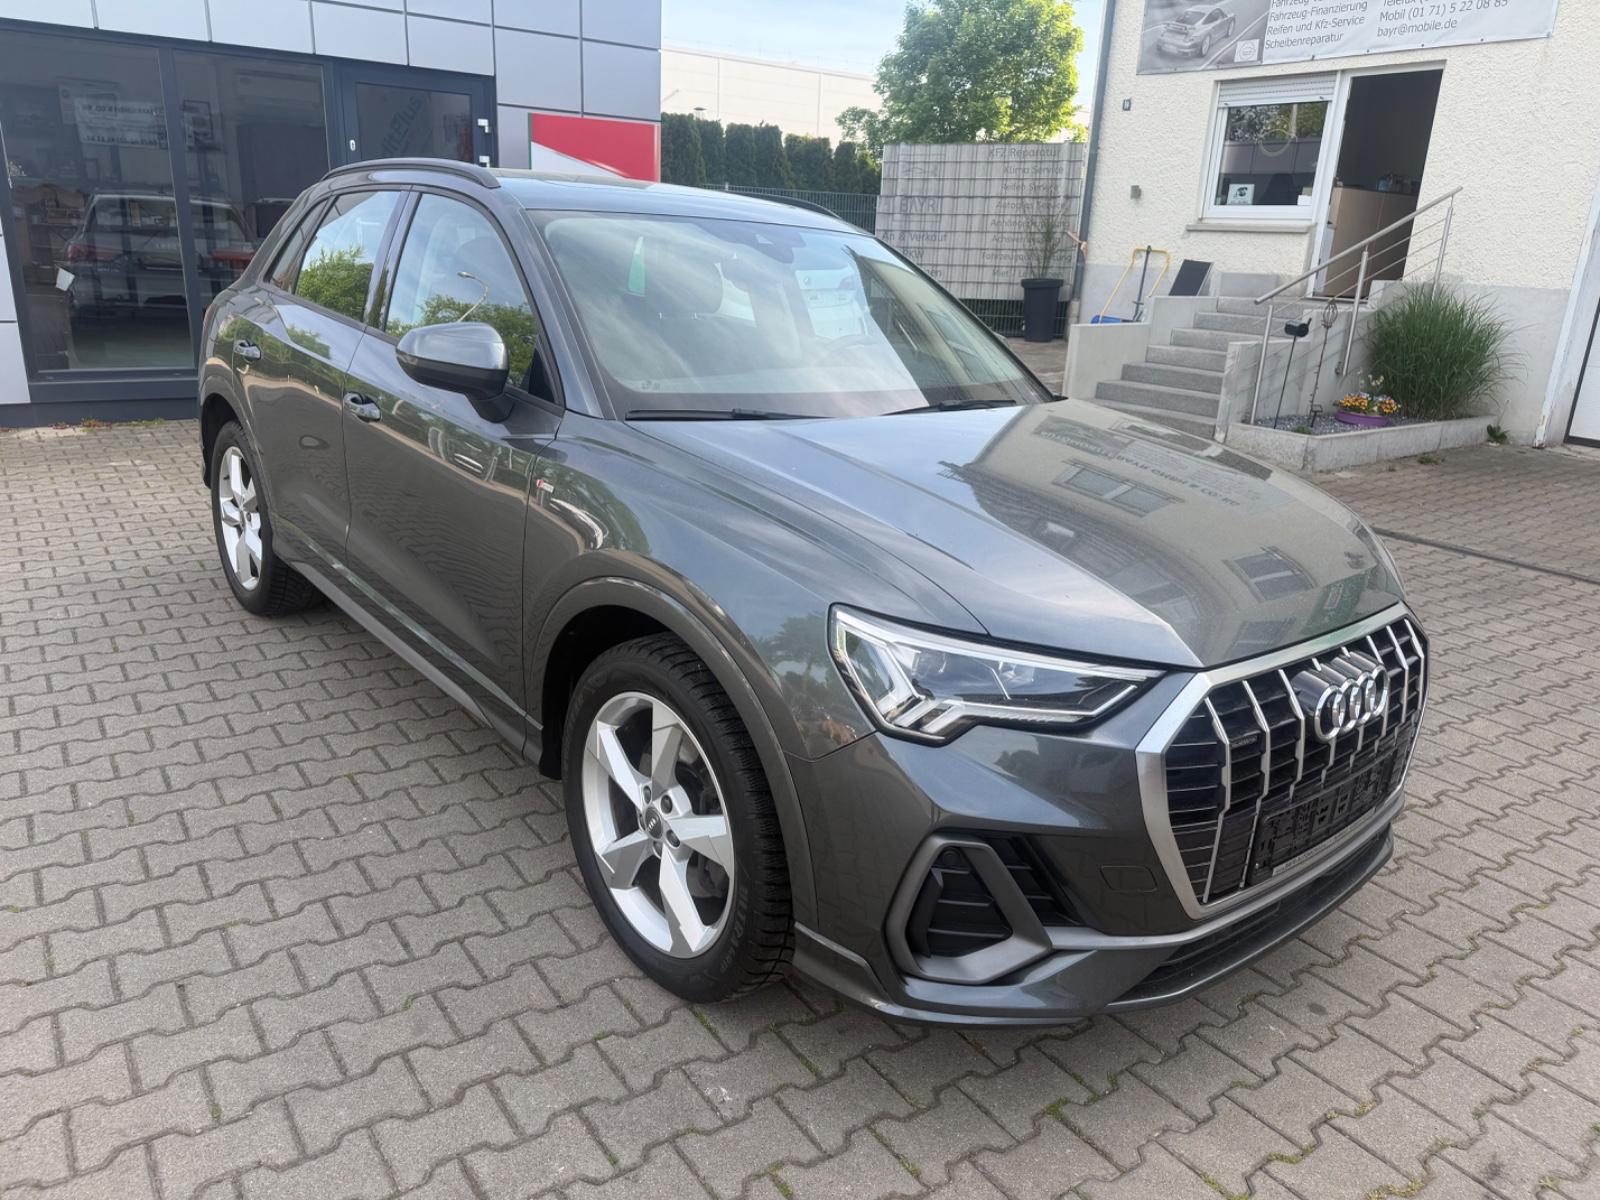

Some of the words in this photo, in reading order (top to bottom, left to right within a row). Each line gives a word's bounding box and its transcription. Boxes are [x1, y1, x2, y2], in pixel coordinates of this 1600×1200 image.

[1270, 1, 1368, 21] Fahrzeug-Finanzierung
[1379, 9, 1405, 22] Mobil
[1408, 7, 1424, 20] (01
[1429, 4, 1446, 17] 71)
[1450, 3, 1456, 14] 5
[1459, 1, 1472, 12] 22
[1267, 24, 1293, 36] Reifen
[1296, 20, 1312, 32] und
[1315, 15, 1365, 30] Kfz-Service
[1377, 18, 1458, 37] bayr@mobile.de
[1265, 32, 1344, 49] Scheibenreparatur
